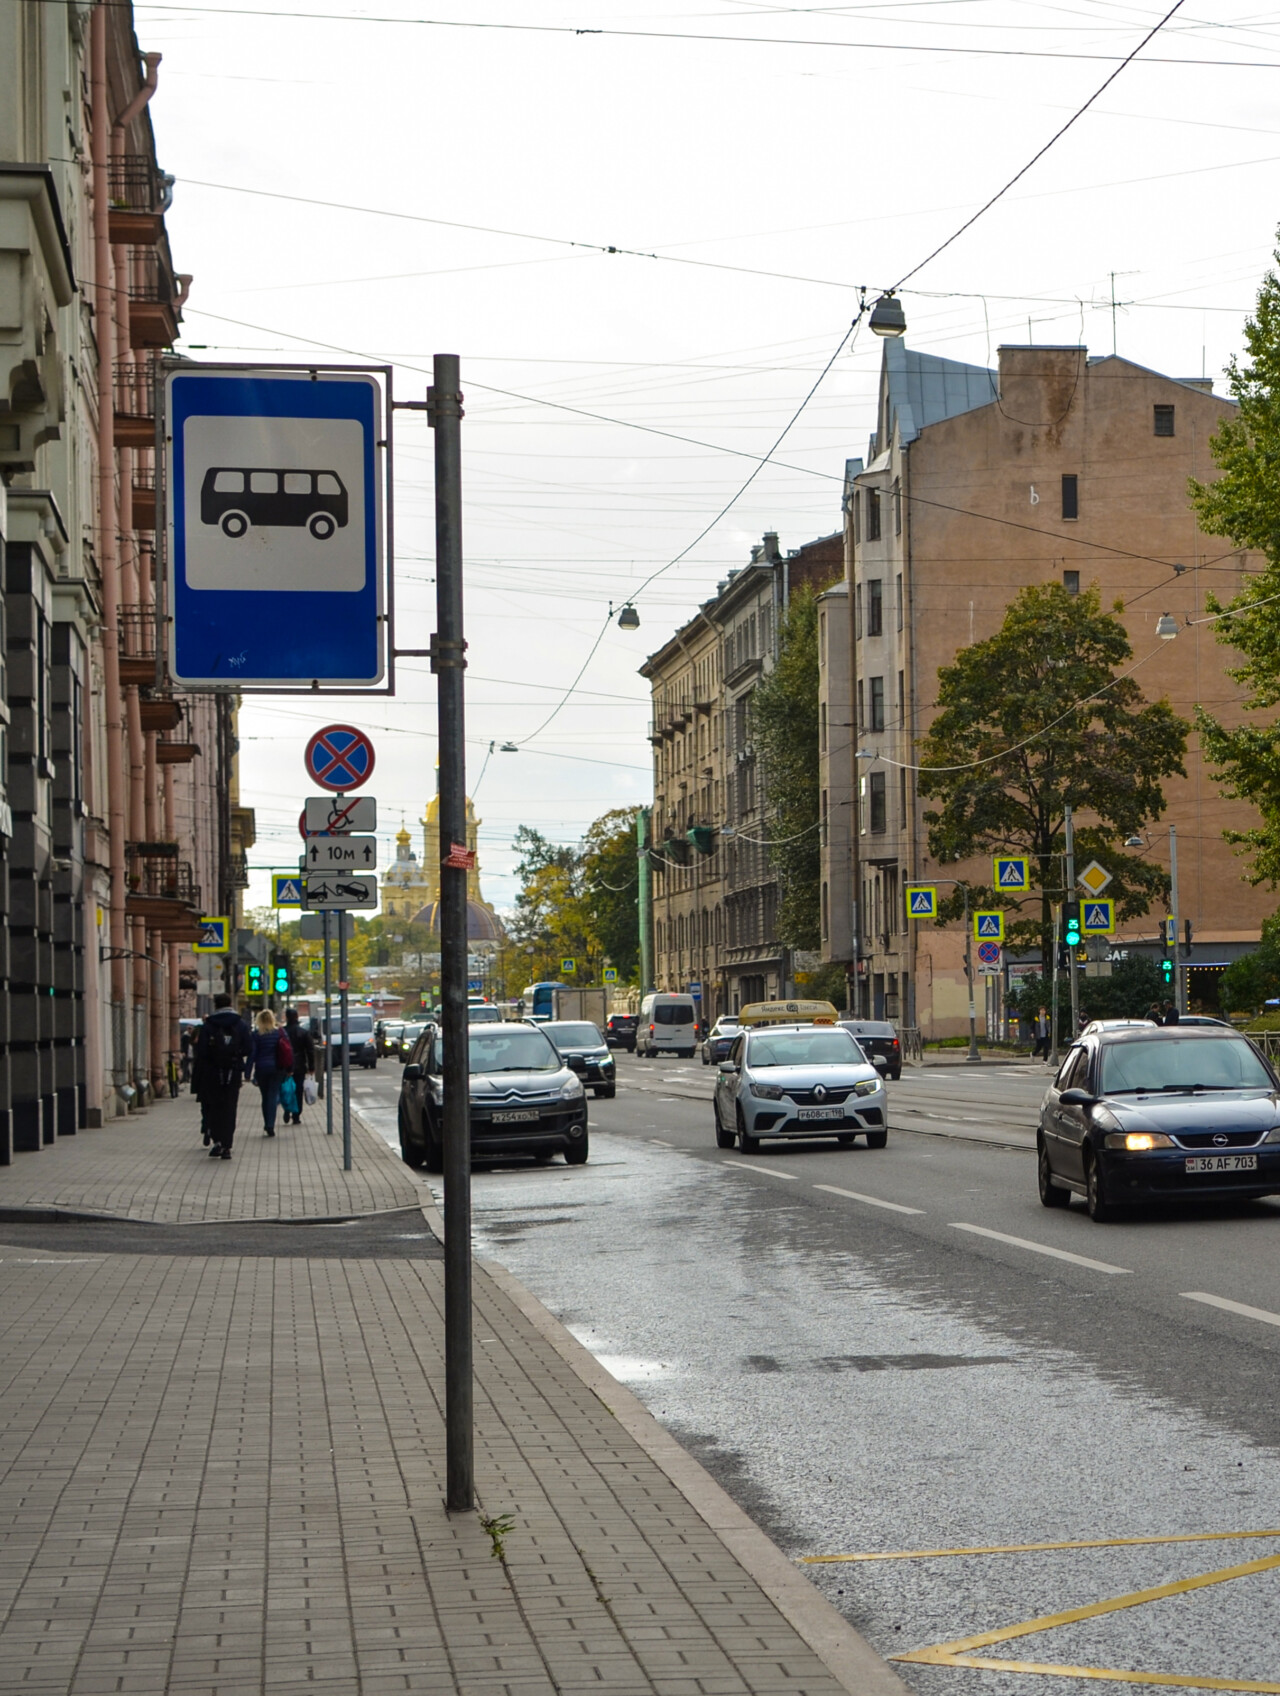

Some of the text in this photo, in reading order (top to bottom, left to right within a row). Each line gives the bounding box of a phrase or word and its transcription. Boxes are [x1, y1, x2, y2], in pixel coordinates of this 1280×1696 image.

[1200, 1156, 1254, 1171] 36 AF 703
